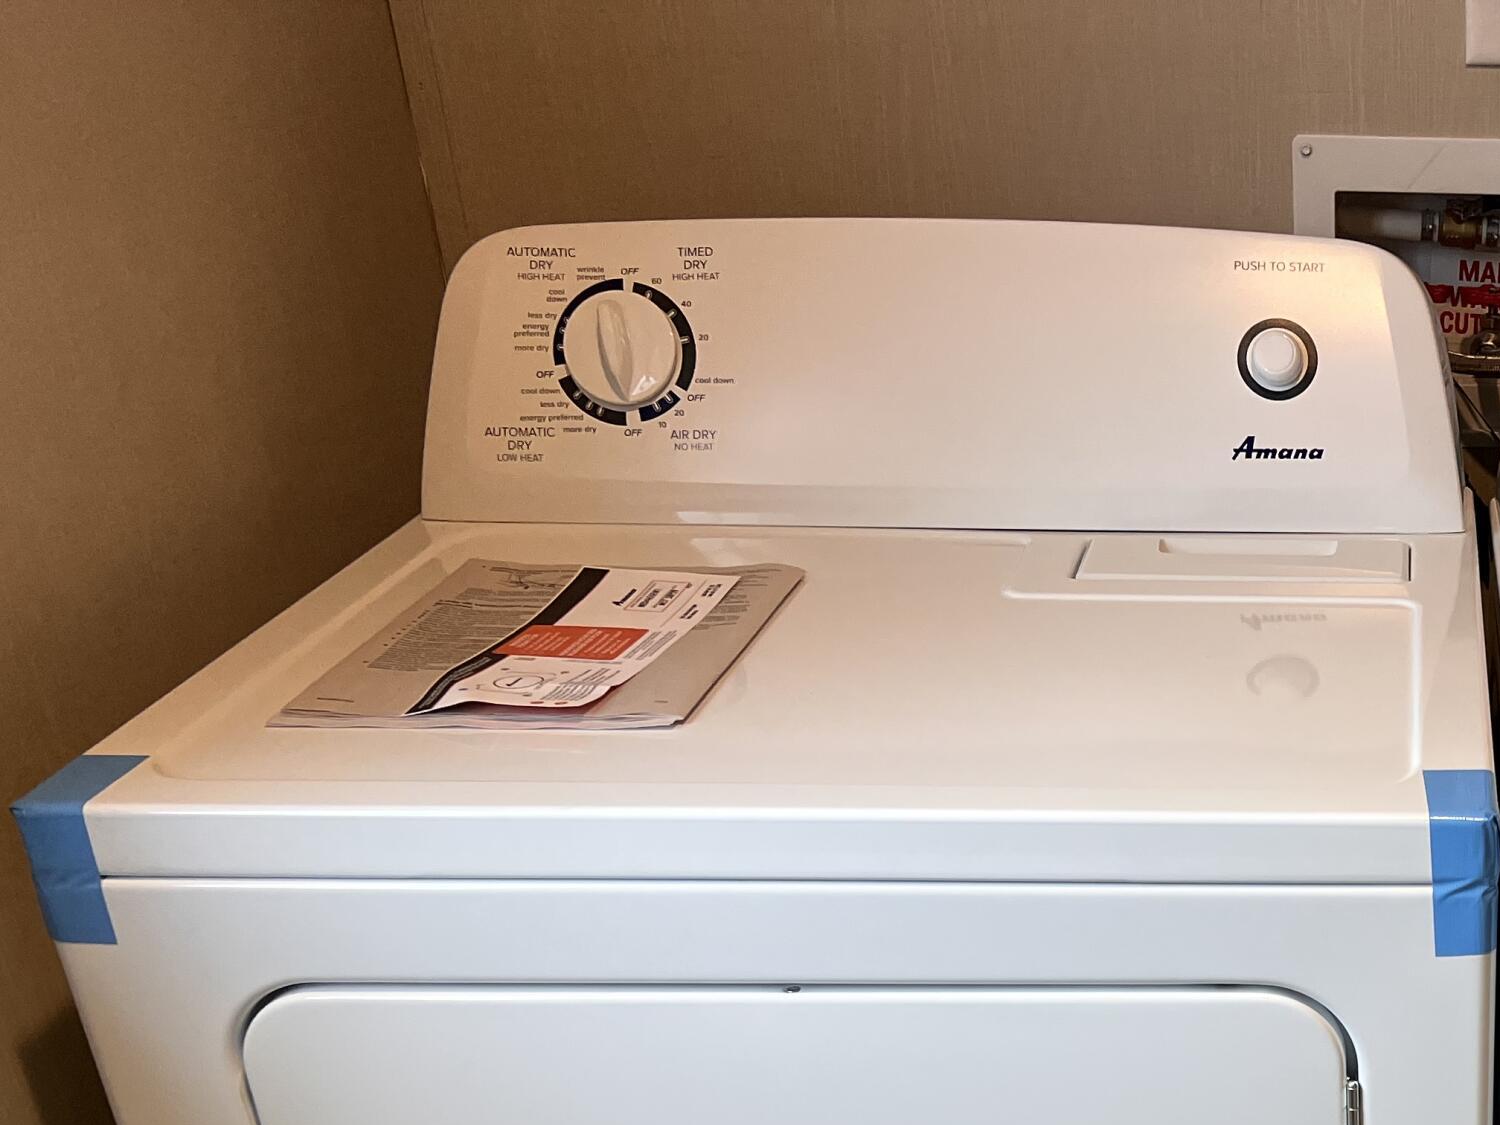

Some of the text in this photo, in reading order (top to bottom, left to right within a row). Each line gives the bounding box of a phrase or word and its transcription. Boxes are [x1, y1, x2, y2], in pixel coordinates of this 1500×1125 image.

[507, 247, 576, 258] AUTOMATIC
[678, 247, 713, 257] TIMED
[530, 260, 553, 270] DRY
[684, 260, 708, 269] DRY
[1234, 261, 1325, 272] PUSH TO START
[698, 272, 720, 280] HEAT
[545, 312, 557, 320] dry
[1440, 311, 1482, 335] CUT
[687, 394, 706, 402] OFF
[548, 414, 584, 422] preferred
[484, 428, 555, 437] AUTOMATIC
[585, 426, 597, 434] dry
[670, 430, 716, 440] AIR DRY
[508, 441, 532, 450] DRY
[1232, 436, 1324, 461] Amana
[497, 454, 543, 462] LOW HEAT
